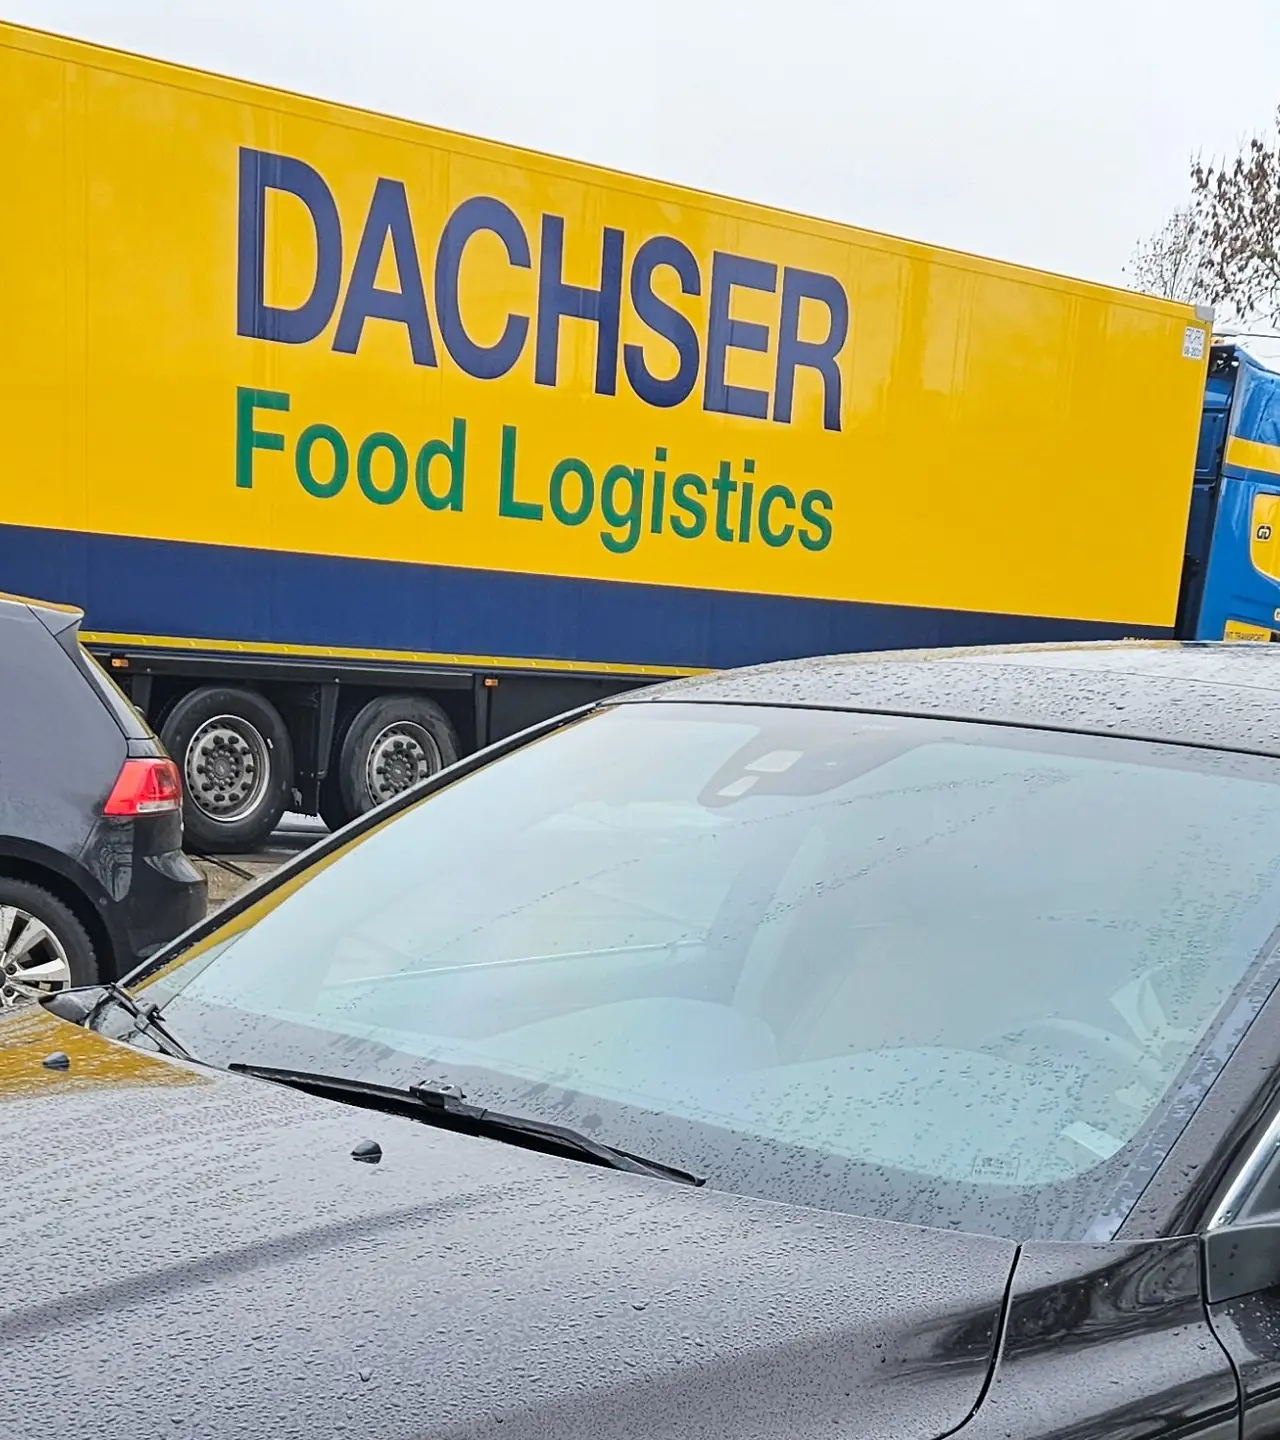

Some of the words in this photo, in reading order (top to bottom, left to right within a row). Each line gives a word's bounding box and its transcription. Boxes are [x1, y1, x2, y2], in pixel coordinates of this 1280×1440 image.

[237, 146, 852, 432] DACHSER
[235, 386, 467, 512] Food
[499, 425, 835, 554] Logistics
